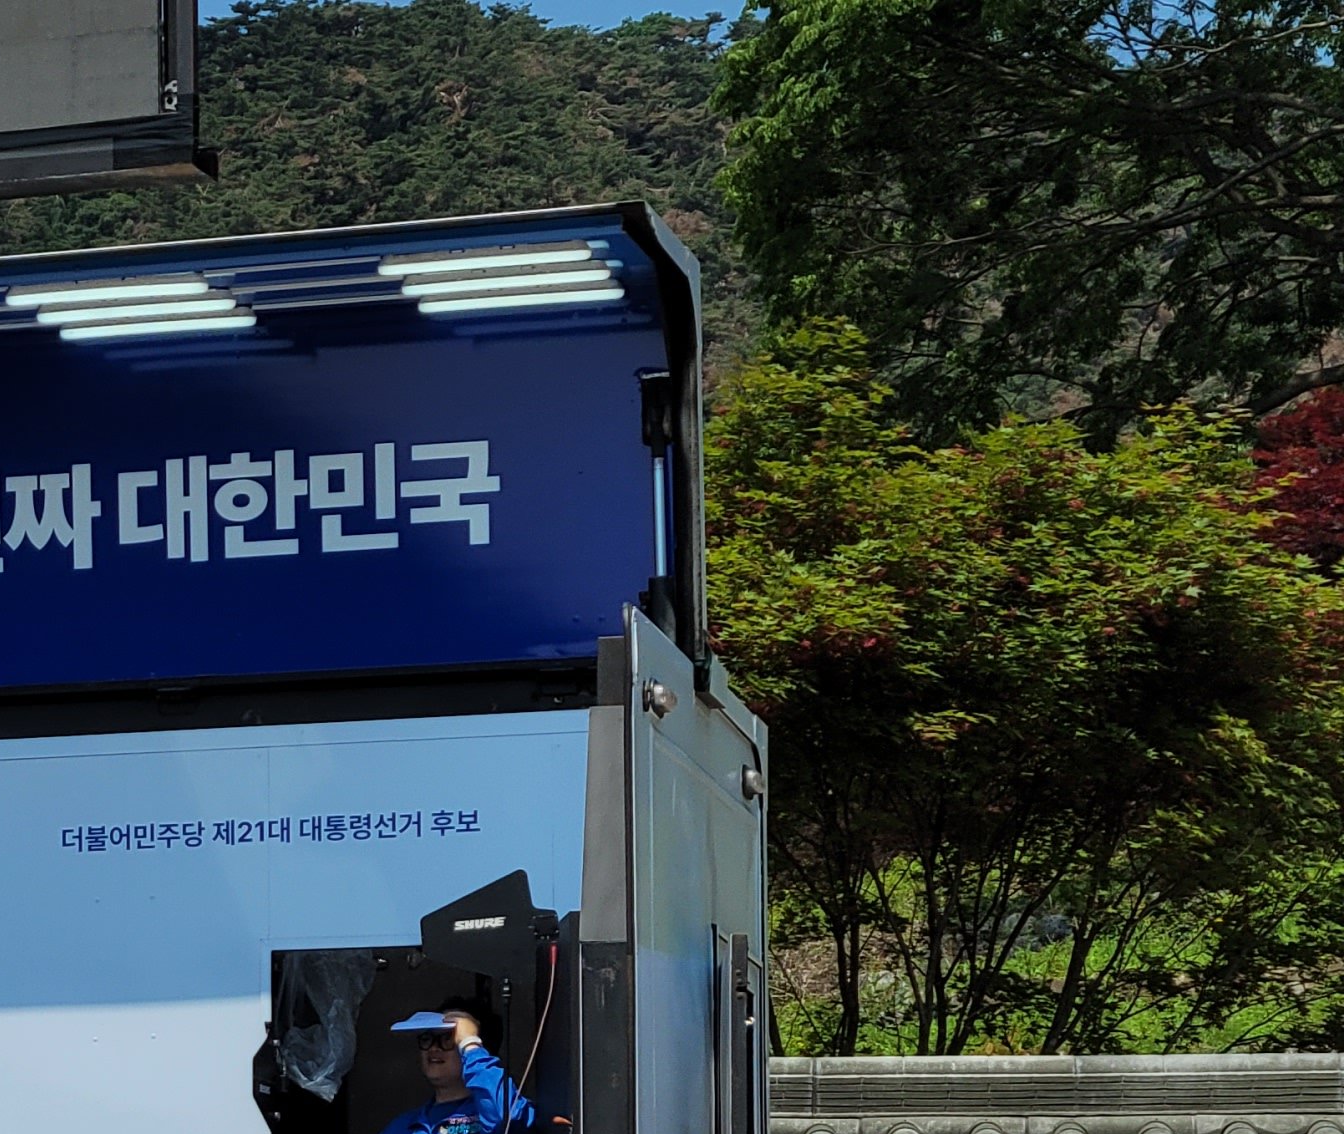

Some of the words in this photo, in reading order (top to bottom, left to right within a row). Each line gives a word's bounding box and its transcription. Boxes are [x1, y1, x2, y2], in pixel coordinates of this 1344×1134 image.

[117, 439, 501, 562] 대한민국
[60, 820, 206, 853] 더불어민주당
[211, 816, 292, 847] 제21대
[298, 810, 424, 842] 대통령선거
[430, 809, 481, 837] 후보
[453, 916, 507, 932] SHURE
